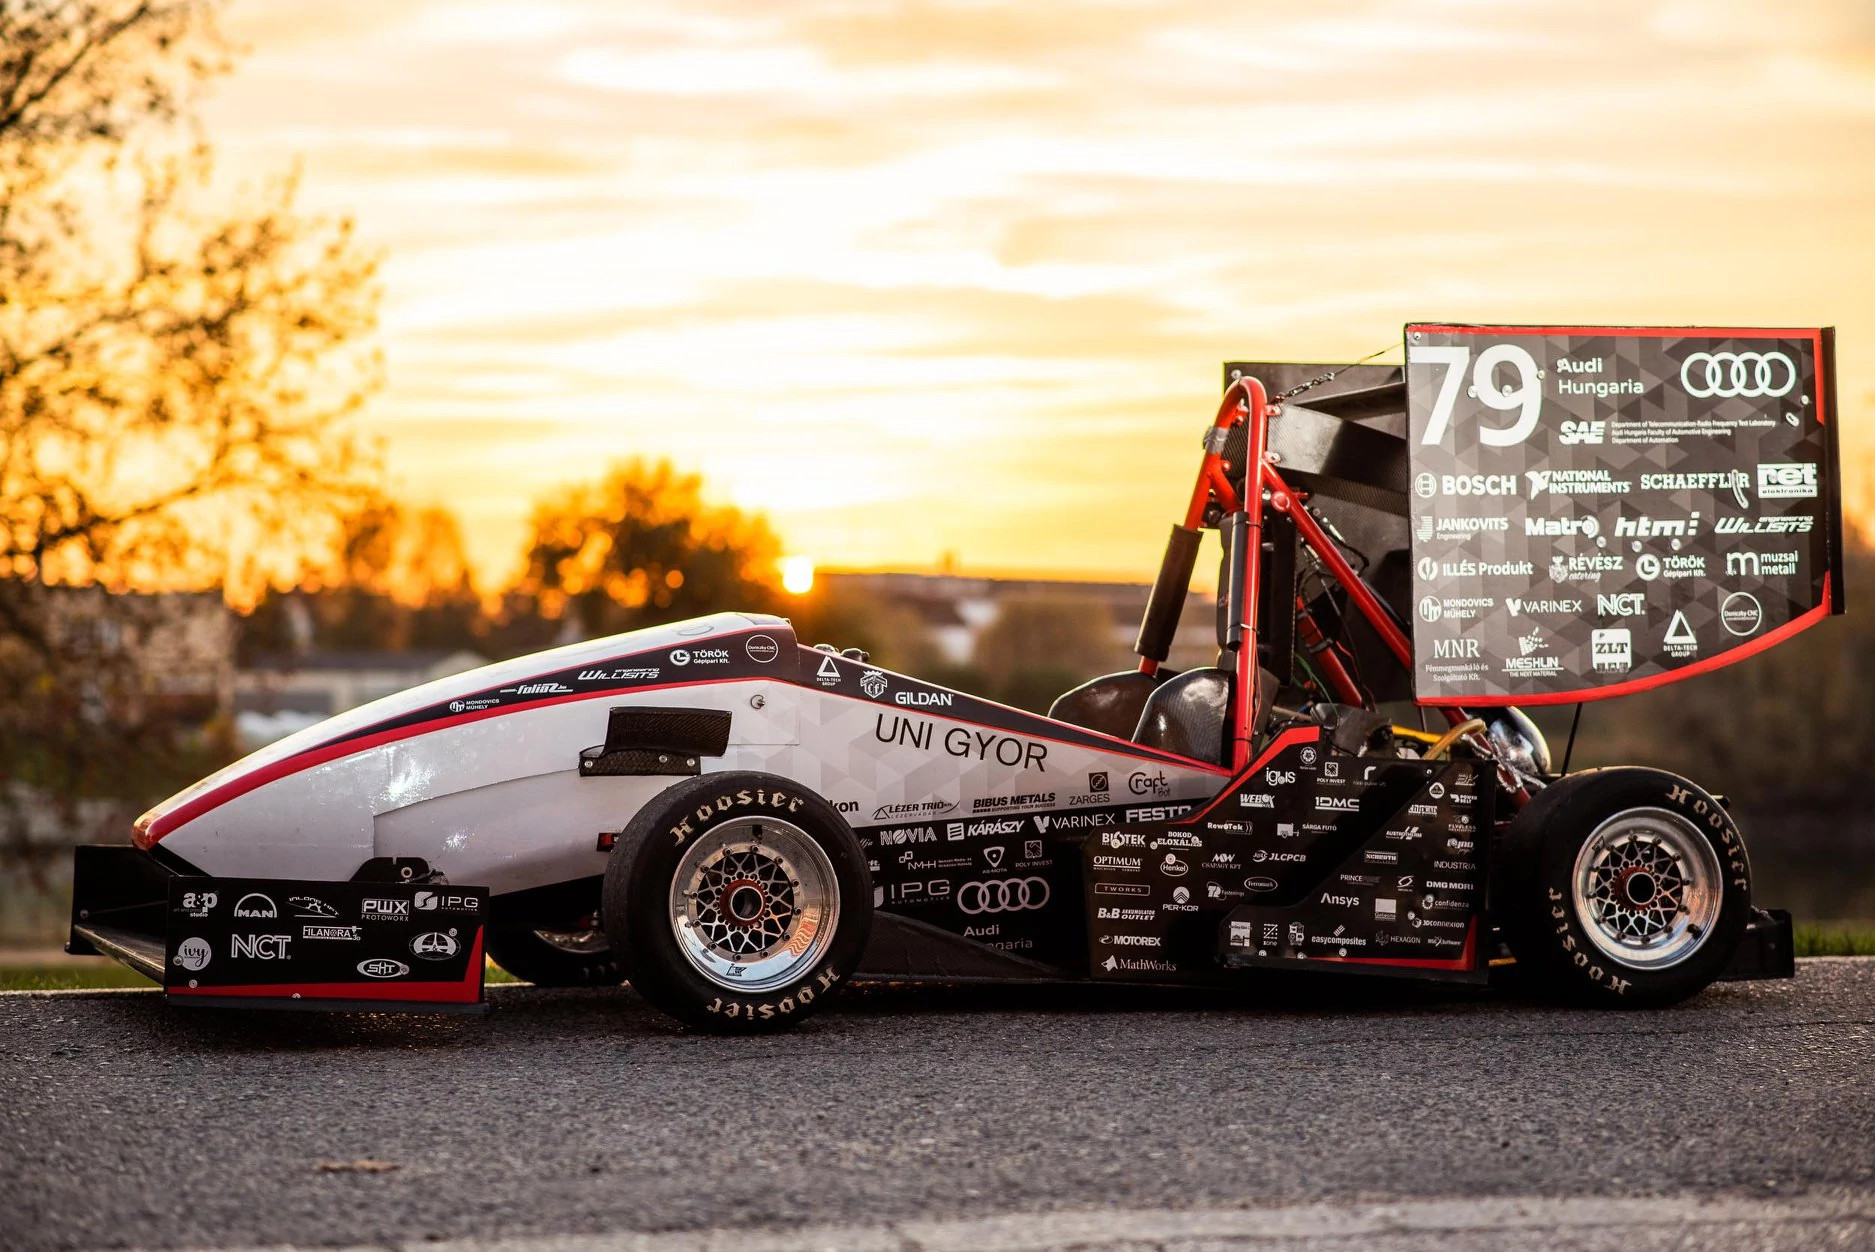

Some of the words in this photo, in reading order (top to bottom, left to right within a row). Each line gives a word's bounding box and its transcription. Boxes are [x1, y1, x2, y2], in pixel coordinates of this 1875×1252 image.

[1557, 357, 1602, 373] Audi
[1559, 379, 1644, 397] Hungaria
[1410, 344, 1542, 447] 79
[1749, 419, 1777, 427] Laboratory
[1559, 420, 1606, 445] SAE
[1553, 470, 1611, 481] NATIONAL
[1442, 475, 1517, 495] BOSCH
[1549, 482, 1631, 494] INSTRUMENTS
[1436, 517, 1509, 531] JANKOVITS
[1568, 553, 1624, 571] RÉVÉSZ
[1662, 555, 1706, 569] TÖRÖK
[1760, 551, 1799, 563] muzsai
[1443, 559, 1476, 577] ILLÉS
[1478, 561, 1534, 576] Produkt
[1761, 563, 1797, 575] metall
[1568, 570, 1602, 583] catering
[1443, 597, 1494, 607] MONDOVICS
[1522, 599, 1583, 614] VARINEX
[1747, 609, 1759, 617] CNC
[693, 648, 729, 659] TÖRÖK
[1433, 638, 1481, 659] MNR
[1595, 643, 1628, 655] ZLT
[1663, 644, 1698, 652] DELTA-TECH
[1505, 656, 1559, 669] MESHLIN
[466, 698, 500, 706] MONDOVICS
[895, 691, 952, 707] GILDAN
[875, 713, 934, 751] UNI
[944, 727, 1048, 773] GYOR
[1128, 770, 1169, 796] Craft
[1157, 787, 1172, 798] Bot
[973, 796, 1008, 809] BIBUS
[1009, 792, 1056, 805] METALS
[1069, 793, 1110, 806] ZARGES
[889, 802, 919, 813] LÉZER
[921, 801, 944, 811] TRIÓ
[1052, 812, 1116, 830] VARINEX
[967, 818, 1026, 838] KÁRÁSZY
[880, 826, 937, 847] NOVIA
[1157, 838, 1203, 848] ELOXÁLS
[1093, 855, 1142, 867] OPTIMUM
[1268, 853, 1307, 862] JLCPCB
[1162, 864, 1187, 873] Henkel
[891, 879, 951, 900] IPG
[1426, 880, 1448, 889] DMG
[1448, 882, 1474, 891] MORI
[182, 892, 218, 913] a&p
[441, 895, 479, 908] IPG
[1320, 892, 1360, 908] Ansys
[1435, 899, 1470, 909] confidenza
[238, 909, 274, 918] MAN
[363, 900, 408, 914] PWX
[1097, 907, 1121, 919] B&B
[1162, 904, 1199, 912] PER-KOR
[361, 913, 409, 922] PROTOWORX
[963, 924, 1000, 937] Audi
[1114, 936, 1161, 947] MOTOREX
[1311, 934, 1367, 947] easycomposites
[1390, 935, 1421, 944] HEXAGON
[184, 945, 209, 967] ivy
[1120, 958, 1177, 971] MathWorks
